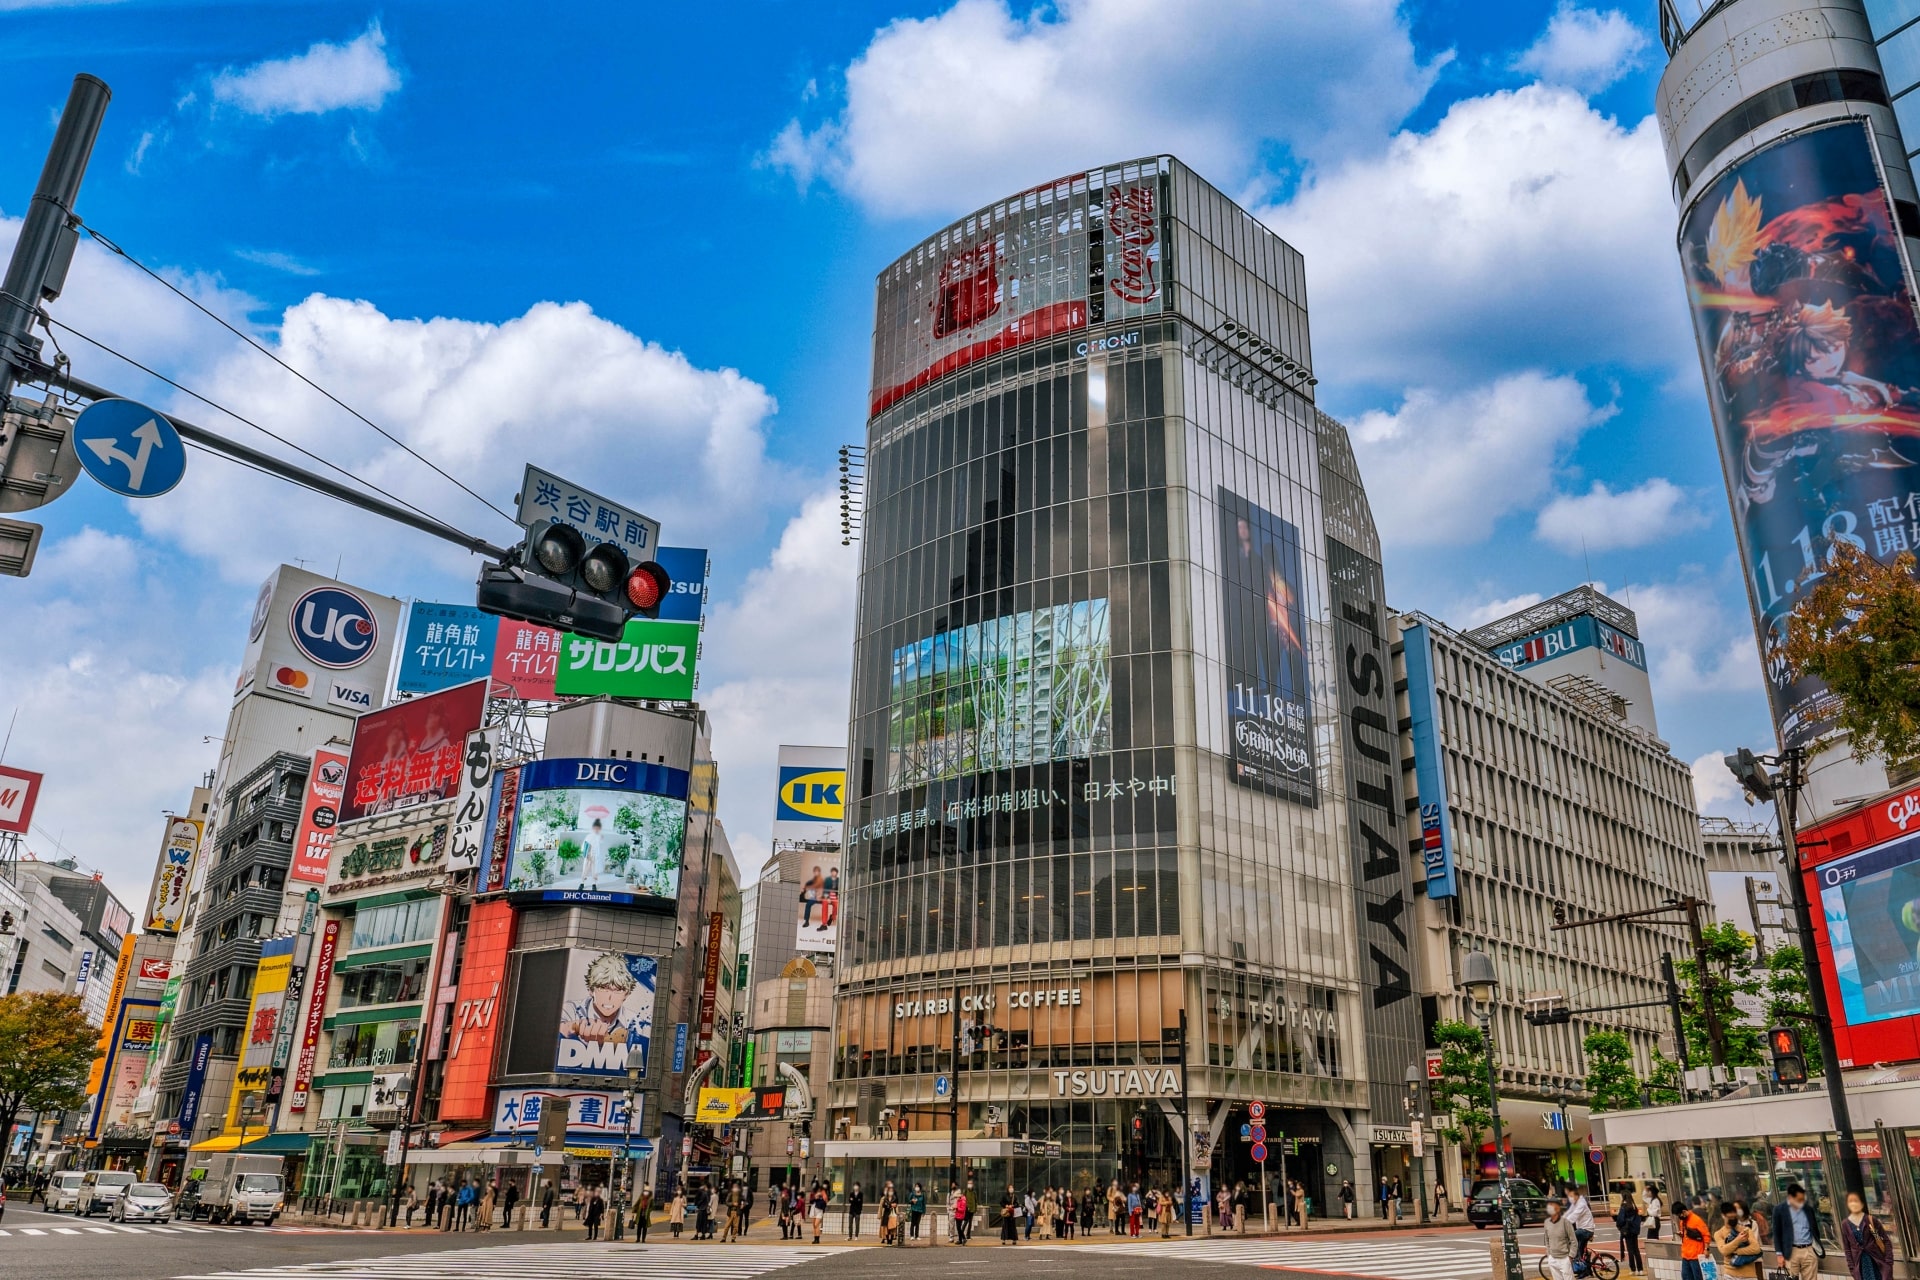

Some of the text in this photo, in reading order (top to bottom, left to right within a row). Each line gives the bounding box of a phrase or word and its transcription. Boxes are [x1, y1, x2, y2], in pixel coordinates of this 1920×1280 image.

[1077, 332, 1139, 357] QFRONT
[533, 479, 649, 548] 渋谷駅前
[302, 601, 368, 650] UC
[426, 622, 480, 646] 龍角散
[416, 646, 487, 670] ダイレクト
[569, 640, 687, 675] サロンパス
[1499, 625, 1578, 669] SEIBU
[1599, 627, 1644, 668] SEIBU
[334, 685, 370, 706] VISA
[1235, 682, 1285, 726] 11.18
[1286, 701, 1305, 720] 配信
[354, 741, 464, 807] 送料無料
[576, 763, 628, 783] DHC
[450, 731, 492, 866] もんじゃ
[791, 782, 842, 806] IK
[947, 787, 1067, 822] 価格抑制狙い、
[1342, 600, 1411, 1010] TSUTAYA
[305, 845, 331, 860] B2F
[309, 831, 333, 846] B1F
[1420, 802, 1447, 881] SEIBU
[563, 891, 612, 901] DHC Channel
[107, 954, 129, 1024] Matsumoto KiYoshi
[1007, 987, 1081, 1008] COFFEE
[251, 1007, 277, 1045] 薬
[701, 990, 715, 1034] 三千里
[1249, 999, 1337, 1034] TSUTAYA
[196, 1043, 209, 1071] MIZUHO
[558, 1038, 643, 1071] DMM
[1053, 1068, 1183, 1096] TSUTAYA
[502, 1096, 632, 1125] 大盛書店
[1541, 1111, 1574, 1131] SEIU
[1374, 1129, 1407, 1142] TSUTAYA
